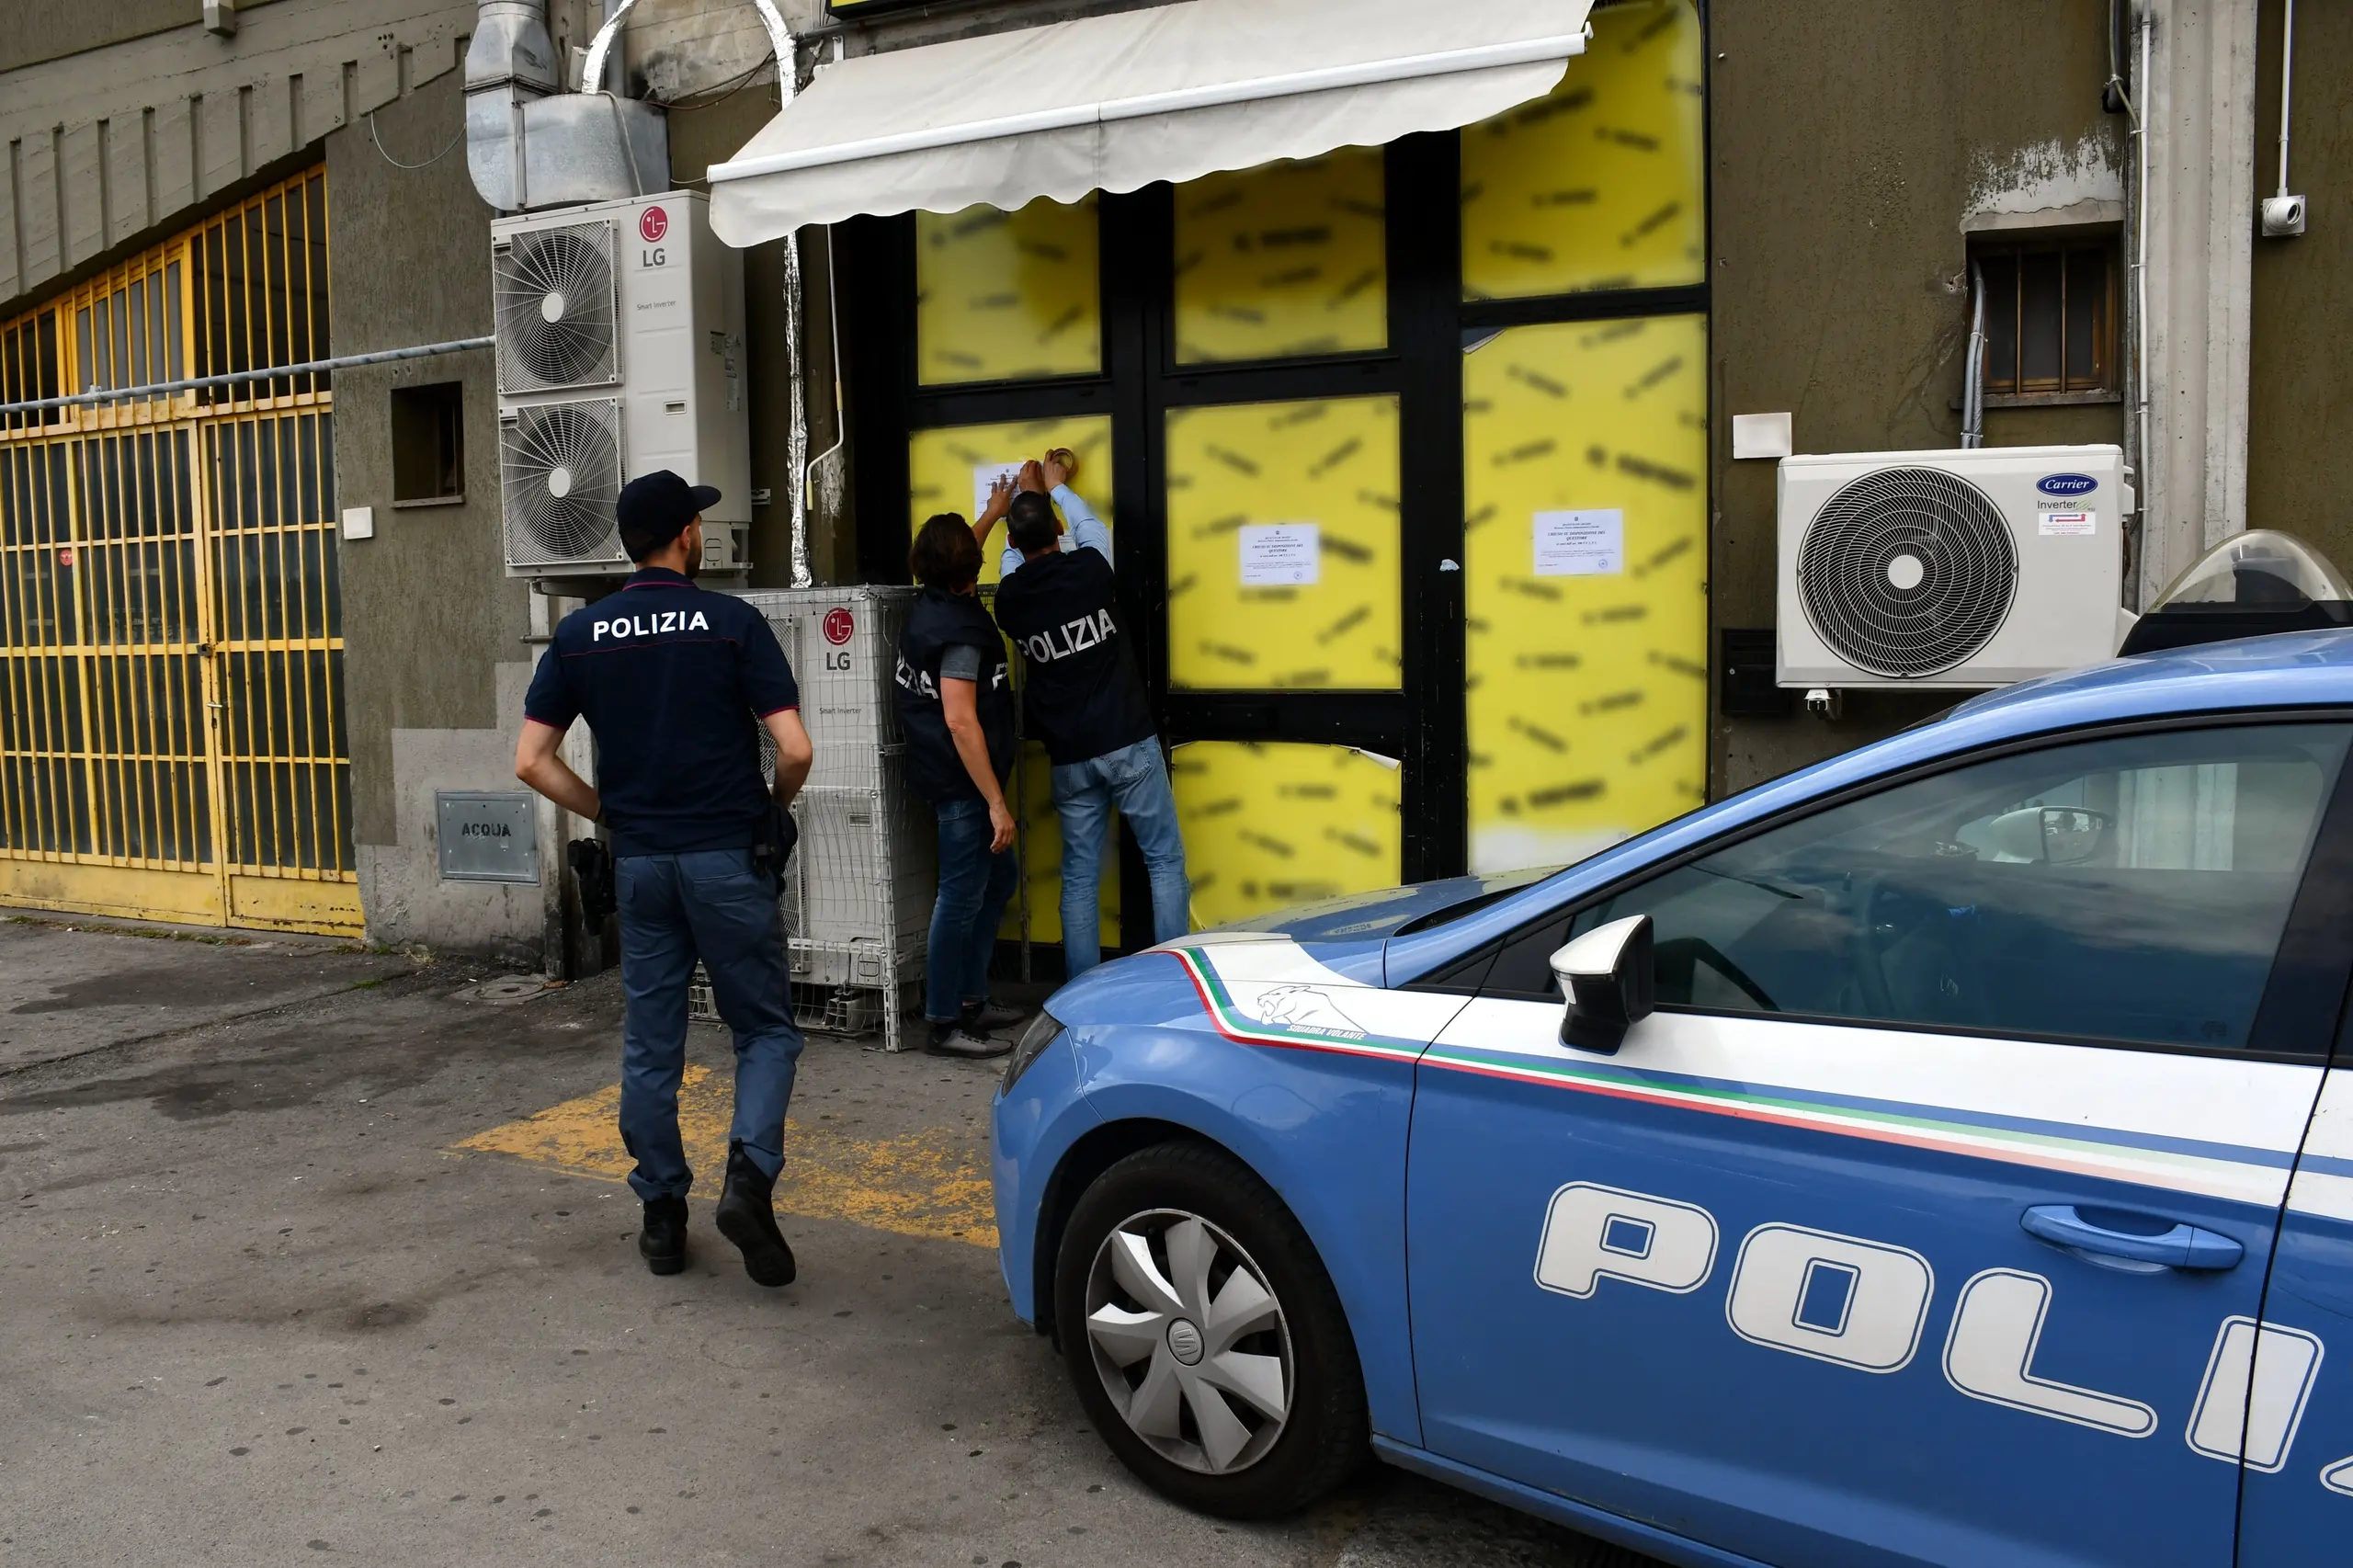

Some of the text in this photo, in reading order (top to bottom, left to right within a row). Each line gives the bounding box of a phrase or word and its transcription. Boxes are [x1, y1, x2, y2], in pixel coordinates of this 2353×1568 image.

[642, 247, 665, 267] LG
[637, 300, 676, 311] Smart Inverter
[2044, 479, 2090, 490] Carrier
[2037, 500, 2078, 509] Inverter
[593, 610, 710, 642] POLIZIA
[826, 652, 851, 671] LG
[819, 707, 862, 715] Smart Inverter
[461, 822, 512, 837] ACQUA
[1287, 1024, 1368, 1040] SQUADRA VOLANTE
[1533, 1180, 2353, 1496] POLI
